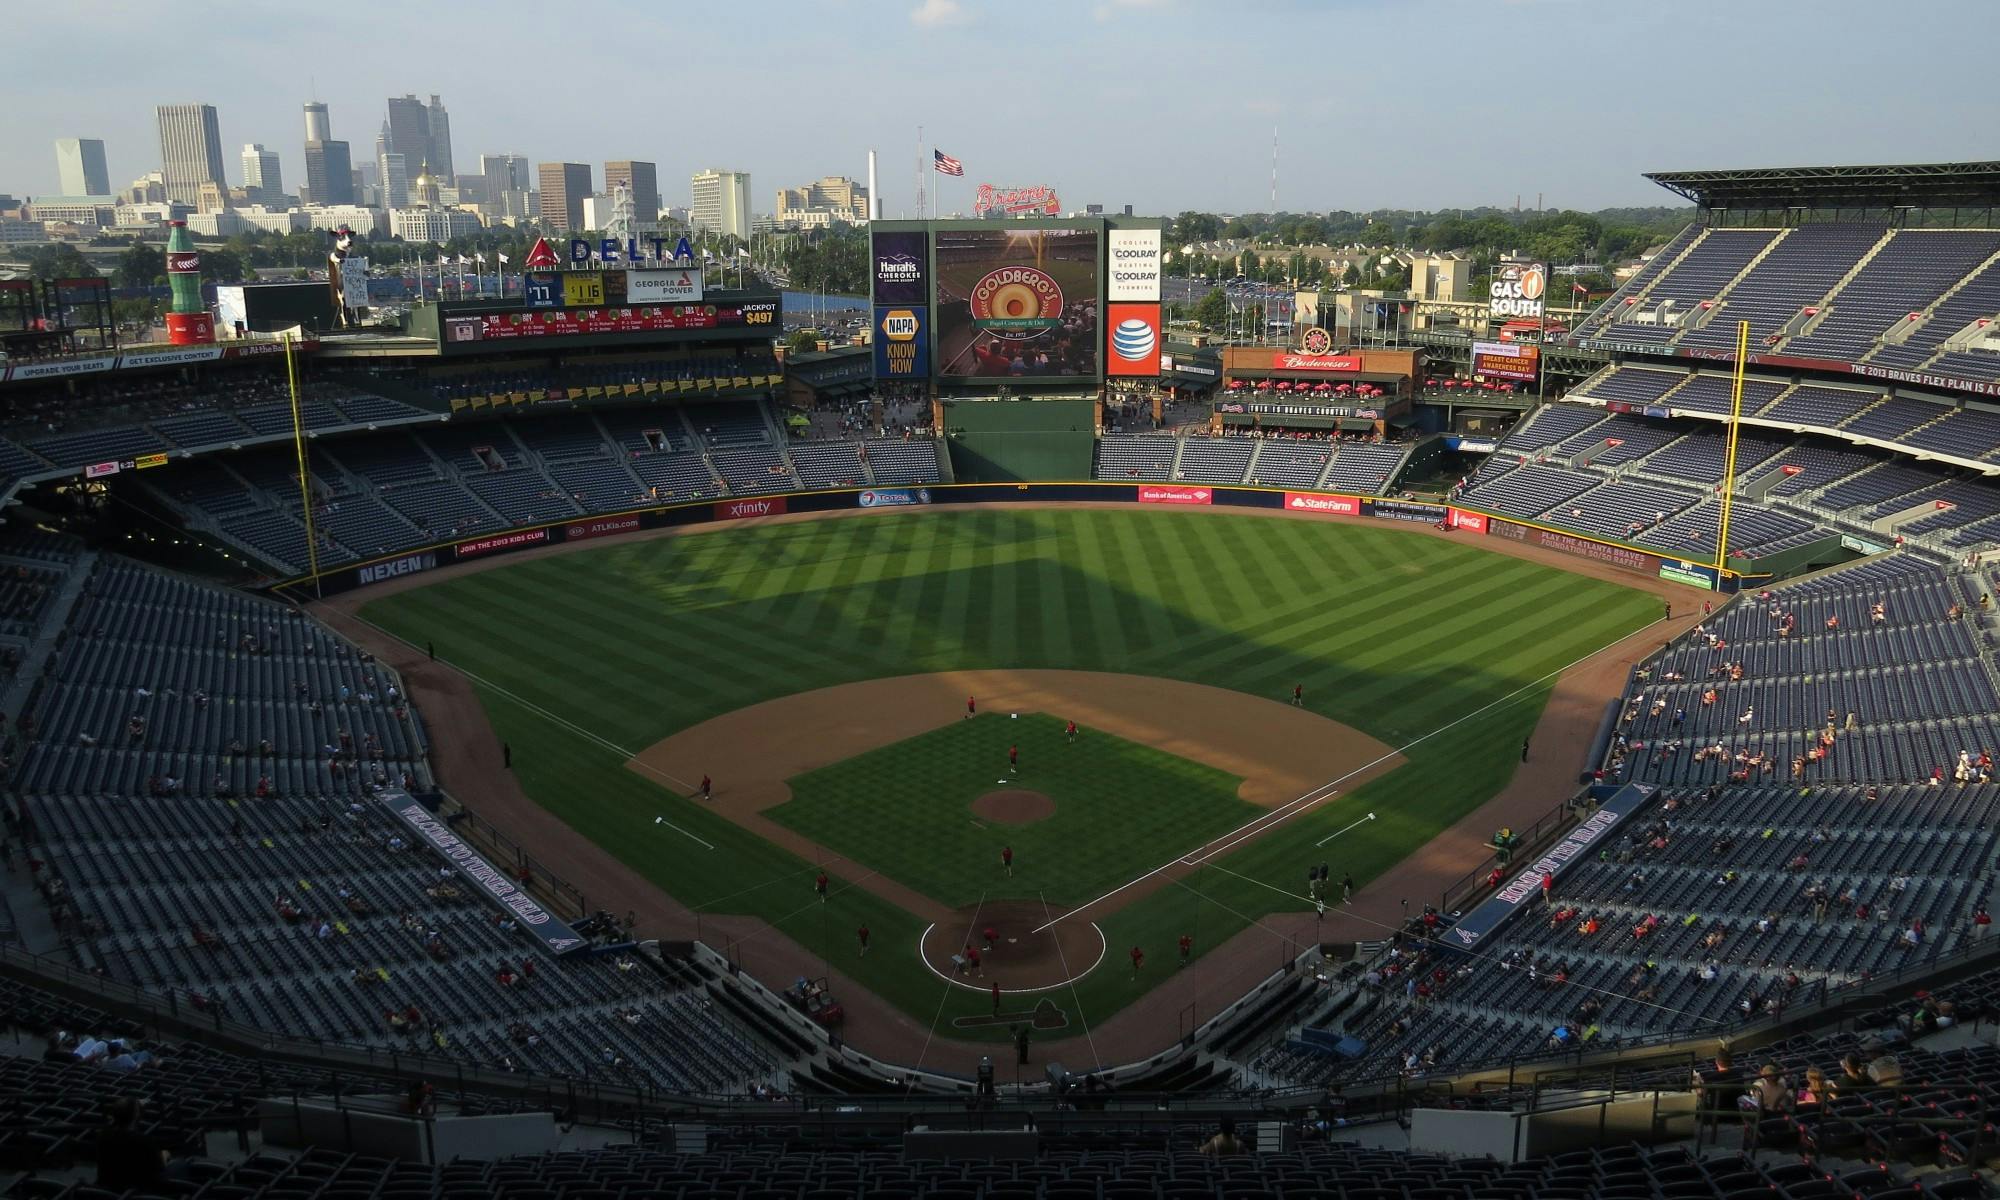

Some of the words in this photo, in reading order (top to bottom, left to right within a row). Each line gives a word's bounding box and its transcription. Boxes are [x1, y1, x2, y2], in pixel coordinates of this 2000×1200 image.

[571, 237, 694, 262] DELTA
[1115, 250, 1157, 258] COOLRAY
[880, 262, 917, 272] Harrah's
[635, 280, 676, 288] GEORGIA
[1115, 272, 1157, 280] COOLRAY
[663, 287, 694, 295] POWER
[977, 270, 1058, 301] GOLDBERG'S
[1491, 281, 1522, 298] GAS
[742, 303, 776, 311] JACKPOT
[1490, 298, 1542, 317] SOUTH
[746, 312, 773, 325] $497
[888, 318, 914, 334] NAPA
[129, 356, 143, 365] GET
[145, 353, 182, 364] EXCLUSIVE
[887, 343, 916, 359] KNOW
[890, 359, 913, 374] HOW
[1283, 356, 1351, 368] Budweiser
[1482, 362, 1517, 371] AWARENESS
[1517, 365, 1531, 373] DAY
[1505, 357, 1529, 365] CANCER
[1851, 364, 1866, 375] THE
[1867, 366, 1887, 378] 2013
[1888, 370, 1921, 383] BRAVES
[1923, 375, 1946, 387] FLEX
[1948, 378, 1972, 391] PLAN
[1975, 383, 1984, 393] IS
[1987, 384, 1994, 395] A
[1144, 491, 1160, 499] Bank
[1167, 491, 1193, 500] America
[731, 500, 771, 517] xfinity
[1305, 498, 1327, 509] State
[1328, 501, 1352, 512] Farm
[591, 519, 639, 533] ATLKia.com
[1458, 514, 1482, 529] Coca-Cola
[460, 544, 477, 554] JOIN
[477, 541, 492, 551] THE
[492, 538, 509, 547] 2013
[510, 535, 526, 543] KIDS
[527, 531, 545, 541] CLUB
[1541, 531, 1560, 542] PLAY
[1562, 535, 1575, 546] THE
[1576, 539, 1612, 555] ATLANTA
[1613, 548, 1646, 562] BRAVES
[1541, 538, 1587, 556] FOUNDATION
[1588, 548, 1612, 561] 50/50
[1613, 556, 1645, 569] RAFFLE
[359, 555, 422, 585] NEXEN
[401, 804, 460, 848] WELCOME
[446, 843, 473, 860] TO
[1496, 870, 1543, 904] HOME
[1532, 857, 1561, 875] OF
[1549, 841, 1586, 861] THE
[1569, 809, 1619, 844] BRAVES
[459, 856, 515, 897] TURNER
[502, 891, 550, 925] FIELD
